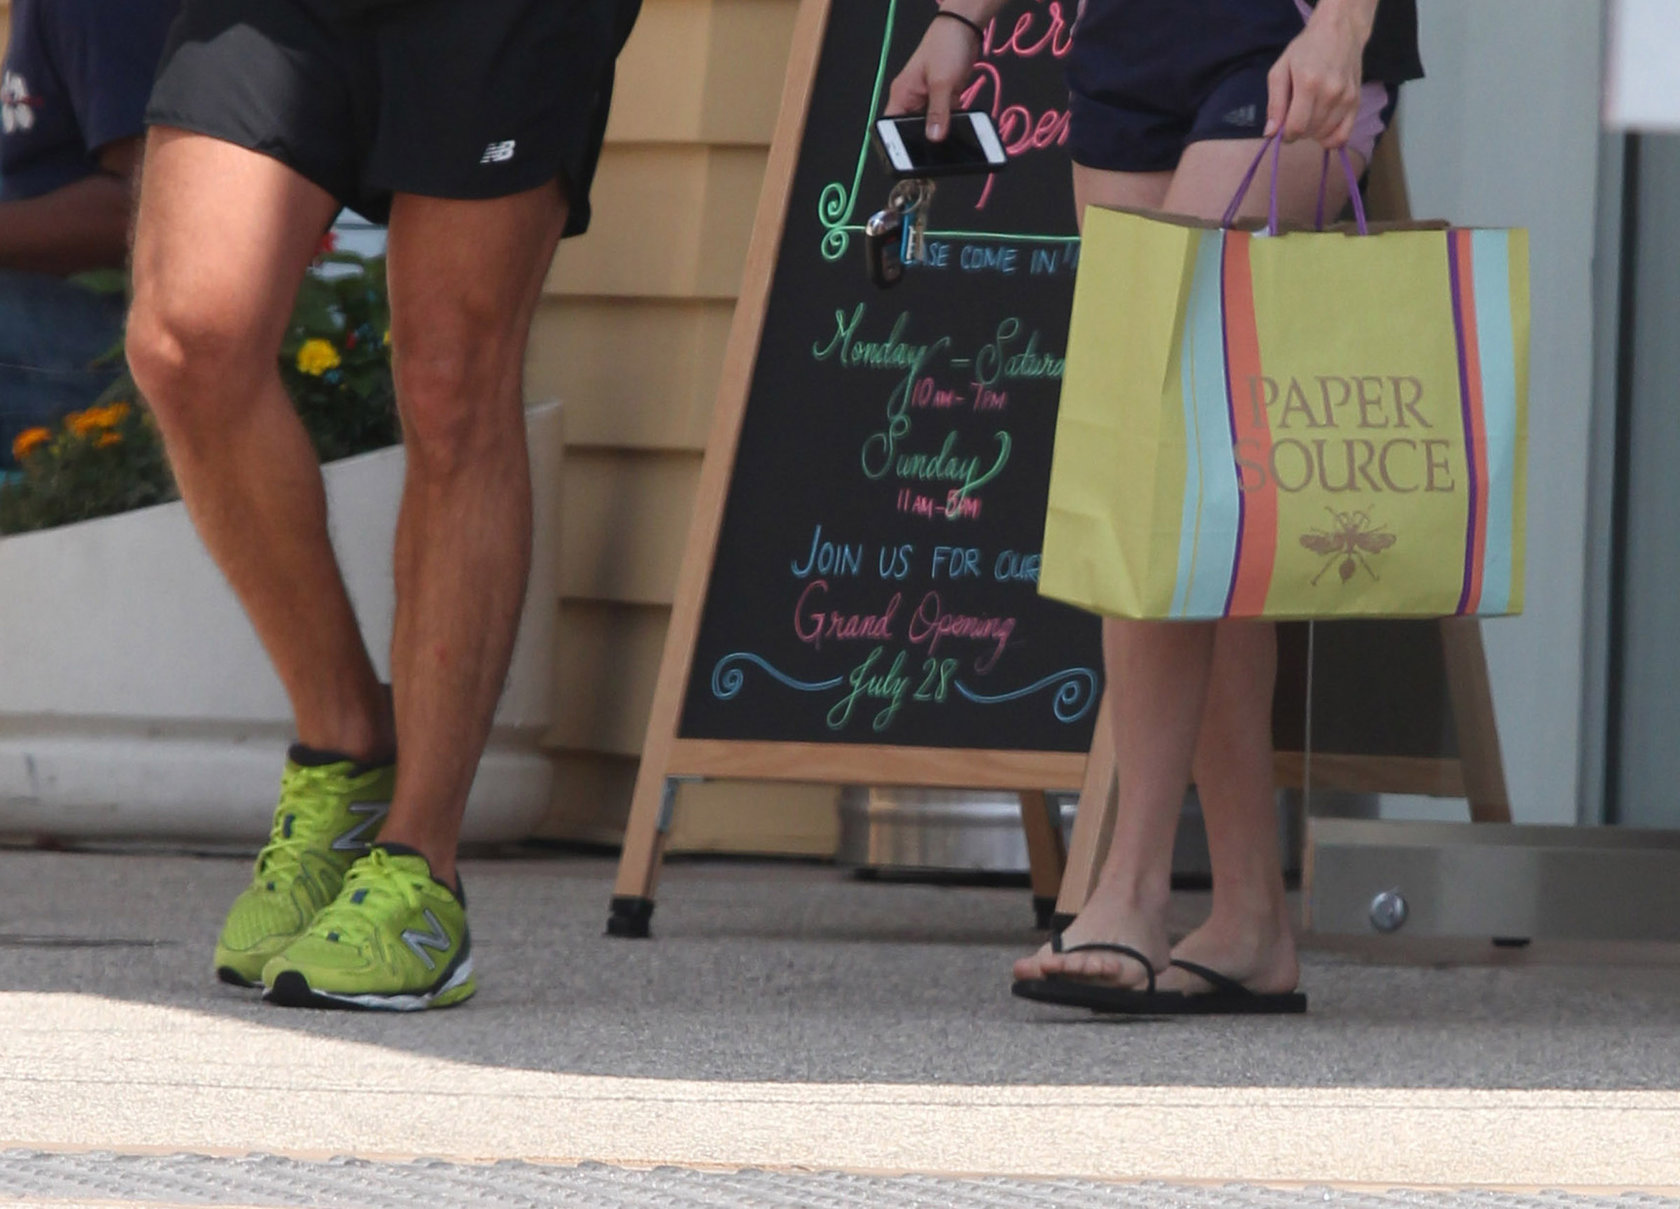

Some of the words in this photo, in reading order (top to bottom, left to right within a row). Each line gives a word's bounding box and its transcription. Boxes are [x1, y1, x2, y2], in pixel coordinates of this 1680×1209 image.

[960, 244, 1019, 274] COME
[813, 302, 950, 420] Monday
[1247, 377, 1433, 429] PAPER
[861, 414, 1012, 521] Sunday
[1235, 437, 1455, 494] SOURCE
[791, 524, 863, 578] JOIN
[879, 545, 913, 580] US
[932, 546, 981, 578] FOR
[795, 579, 902, 650] Grand
[909, 591, 1017, 674] Opening
[827, 646, 909, 730] July
[912, 658, 958, 703] 28
